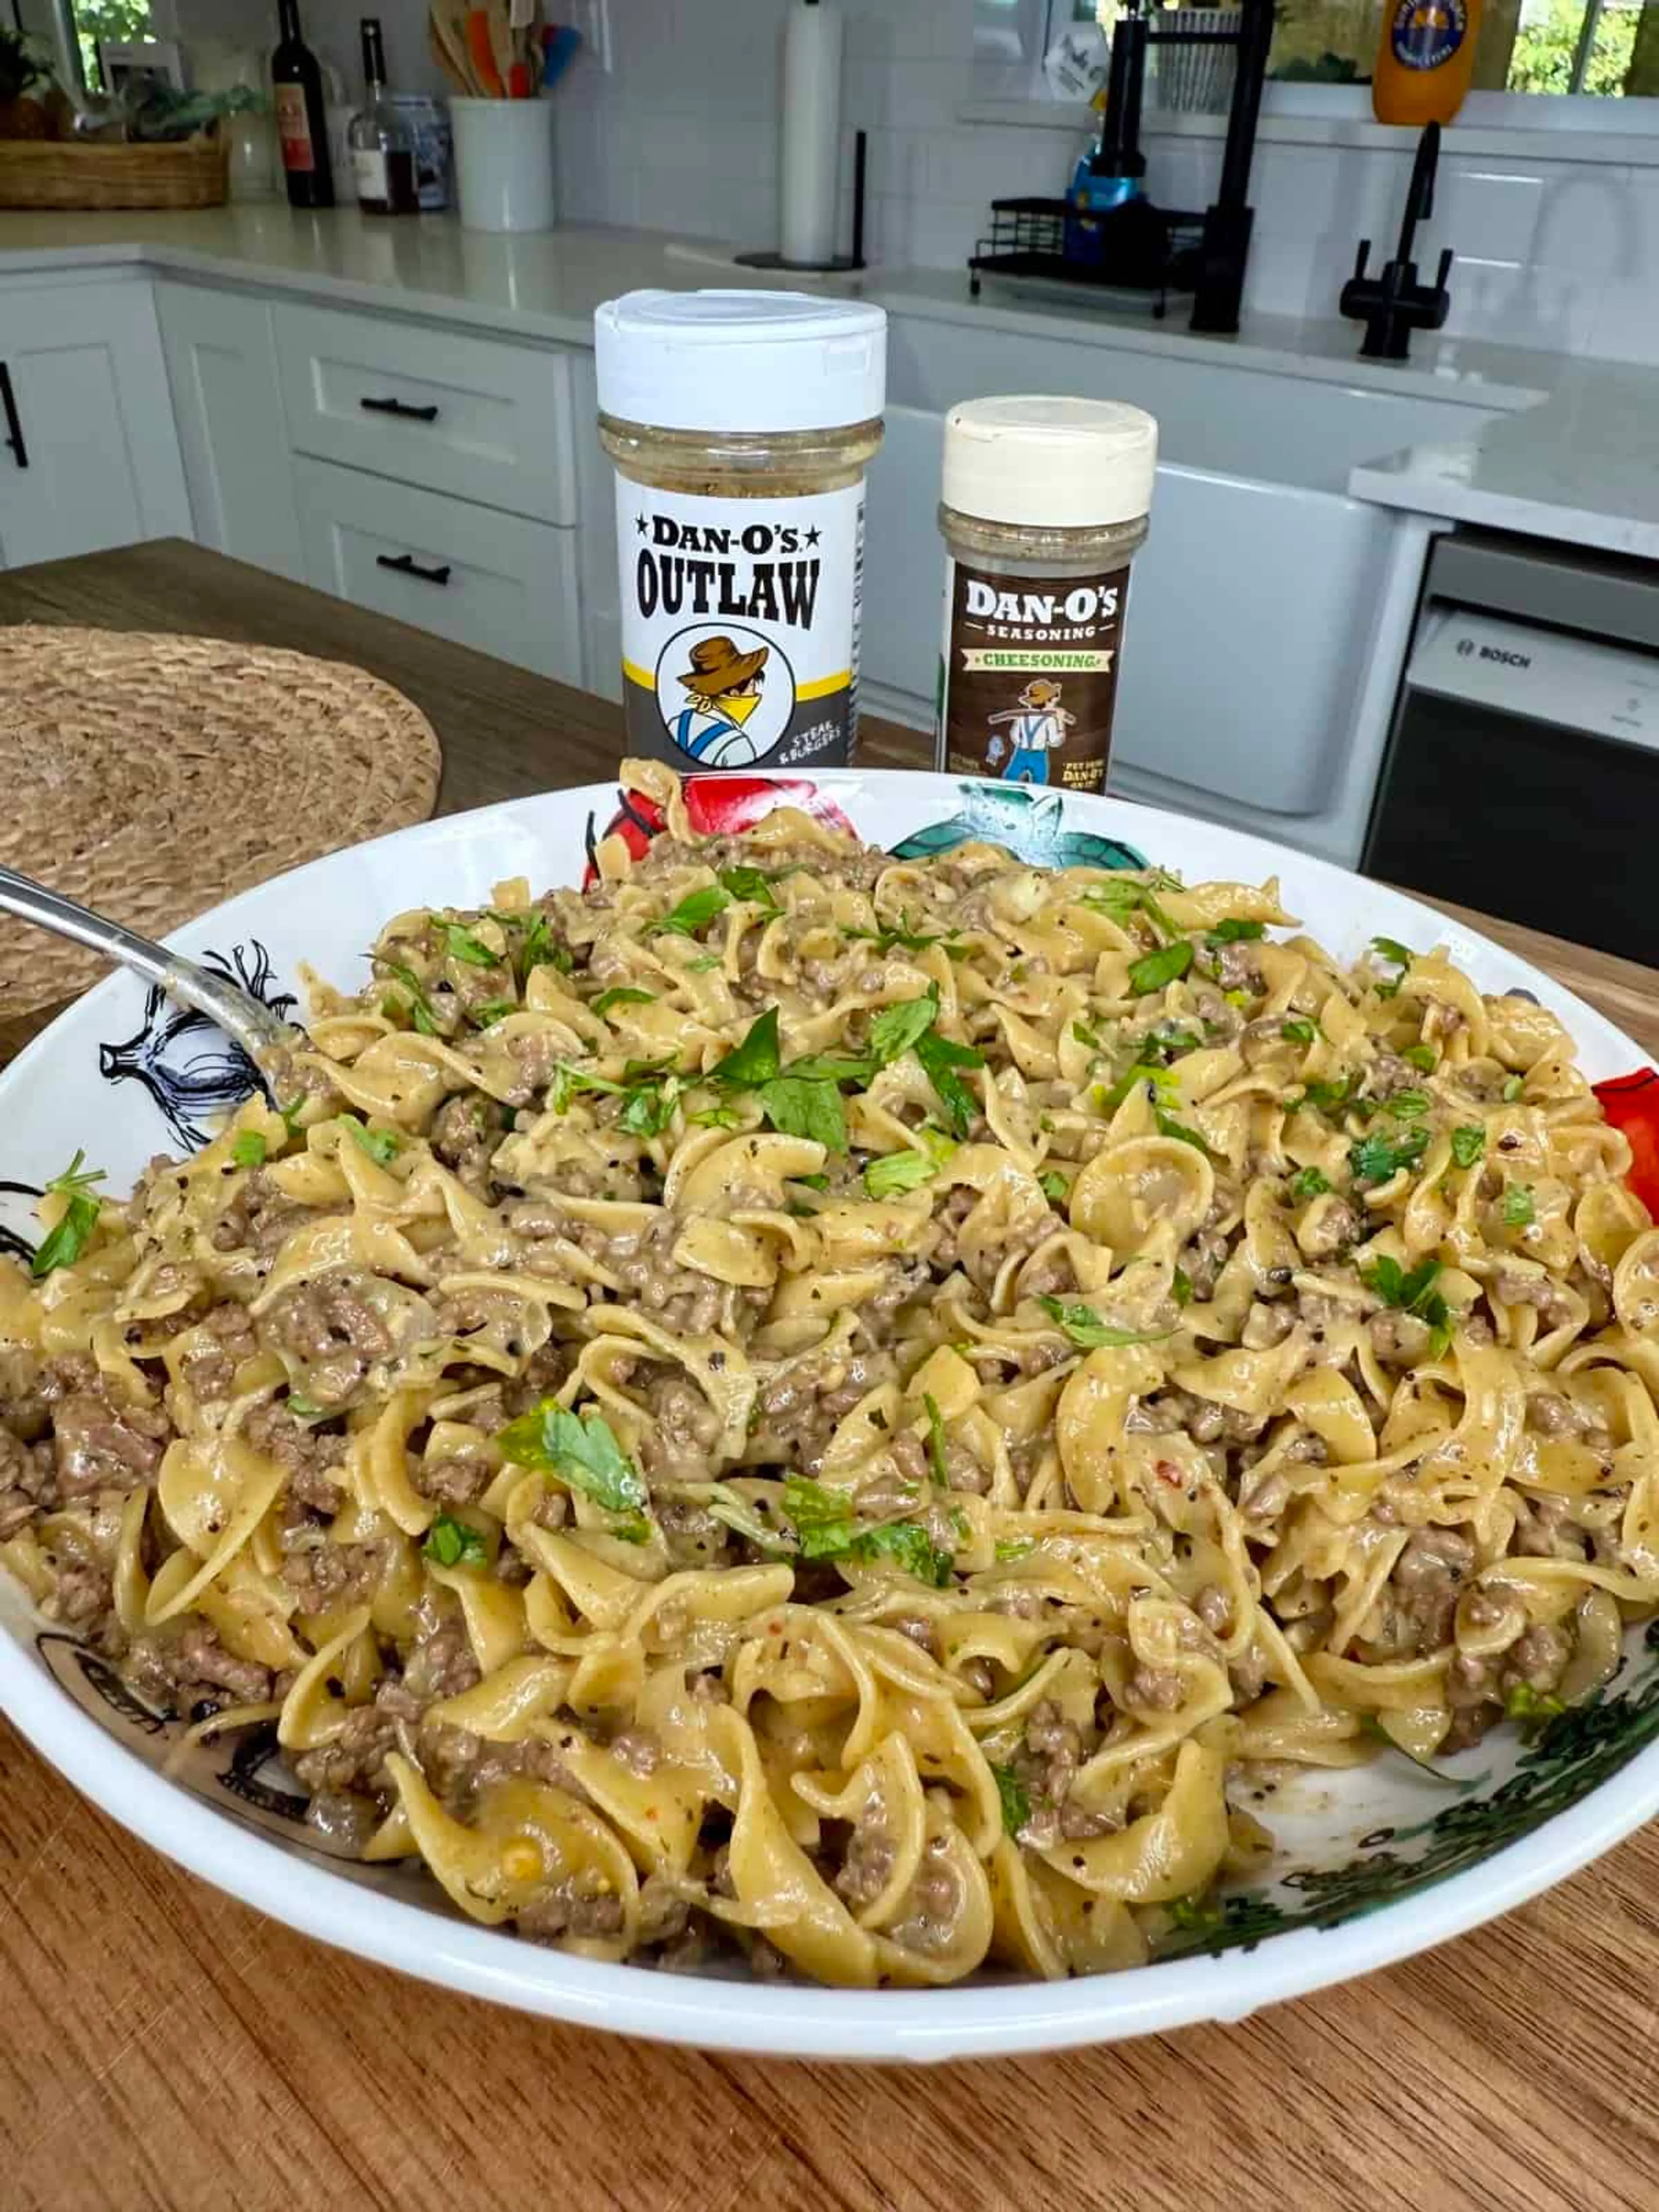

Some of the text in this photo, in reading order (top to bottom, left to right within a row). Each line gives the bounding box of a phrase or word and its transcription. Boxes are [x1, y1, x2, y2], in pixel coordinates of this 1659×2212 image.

[652, 514, 799, 555] DAN-O'S
[637, 548, 820, 631] OUTLAW
[966, 579, 1119, 624] DAN-O'S
[987, 624, 1096, 641] SEASONING
[983, 652, 1096, 668] CHEESONING
[1479, 645, 1531, 668] BOSCH
